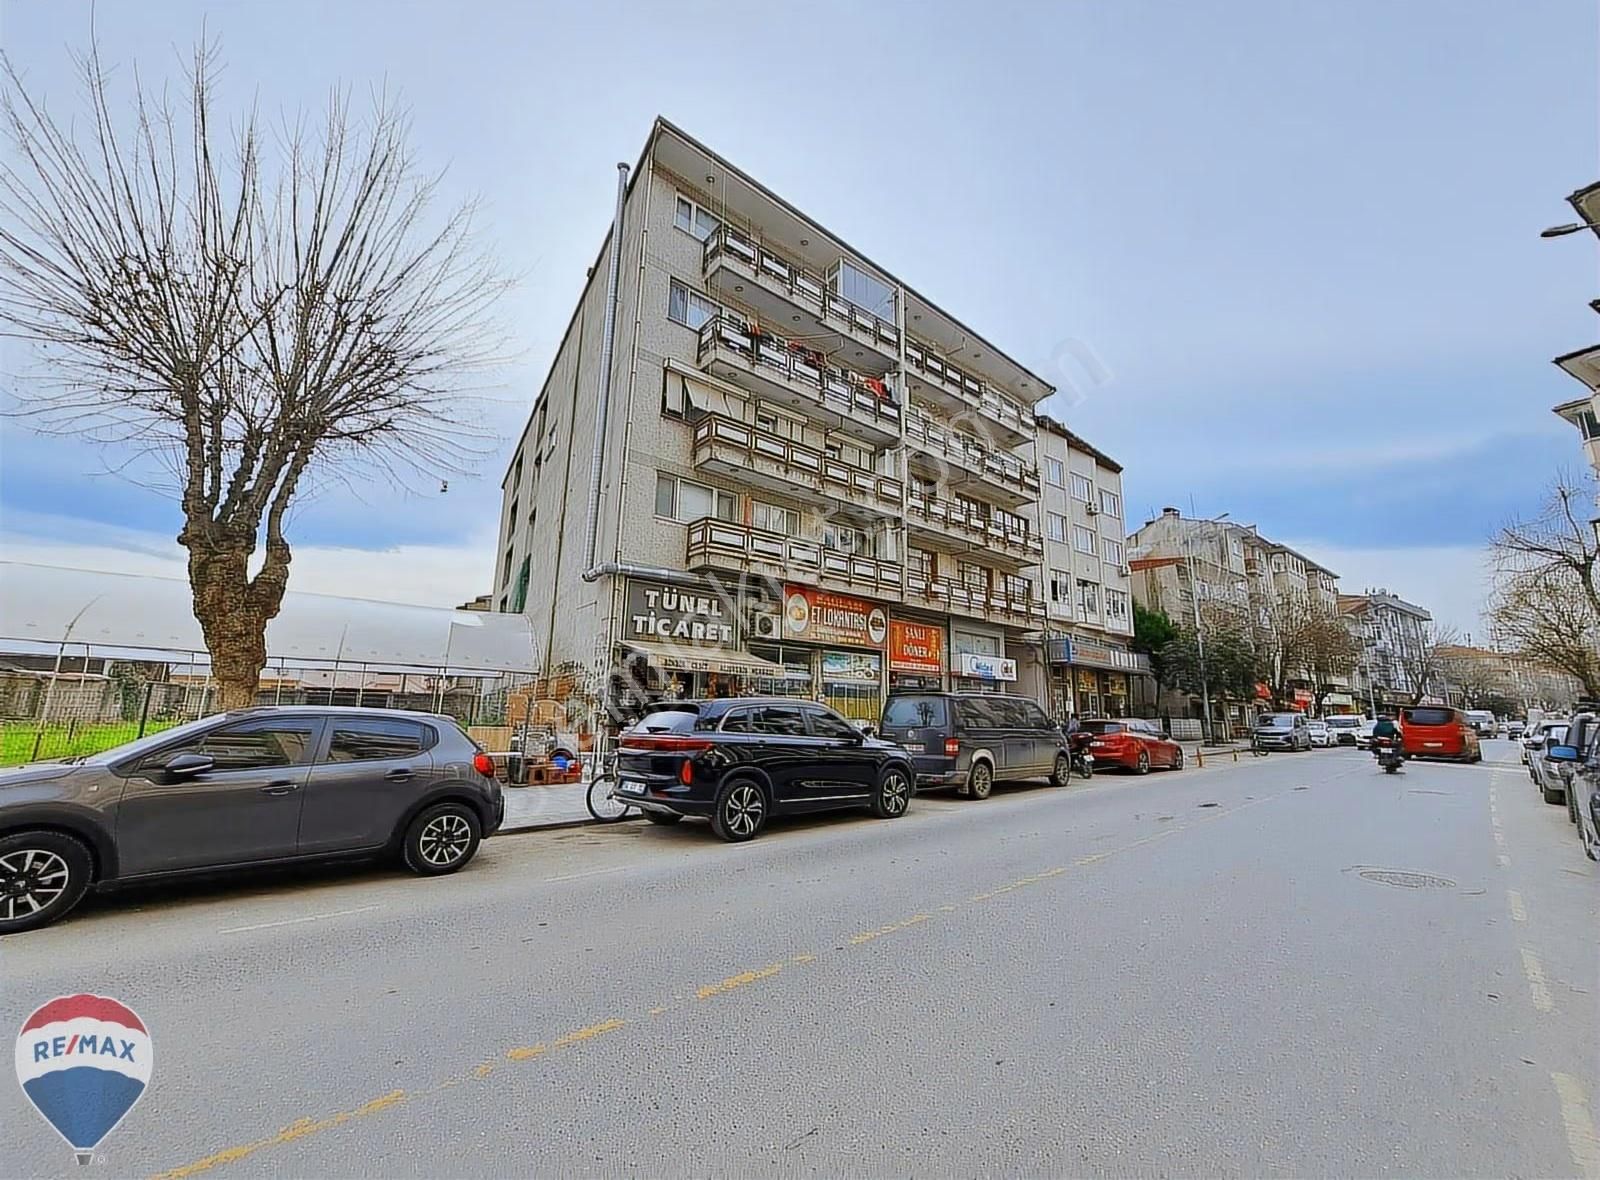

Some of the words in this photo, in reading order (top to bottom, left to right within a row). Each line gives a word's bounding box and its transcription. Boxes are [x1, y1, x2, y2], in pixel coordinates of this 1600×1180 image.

[645, 587, 722, 617] TÜNEL
[632, 611, 732, 642] TİCARET
[811, 606, 821, 624] ET
[823, 607, 867, 631] LOKANTASI
[903, 642, 928, 658] DÖNER
